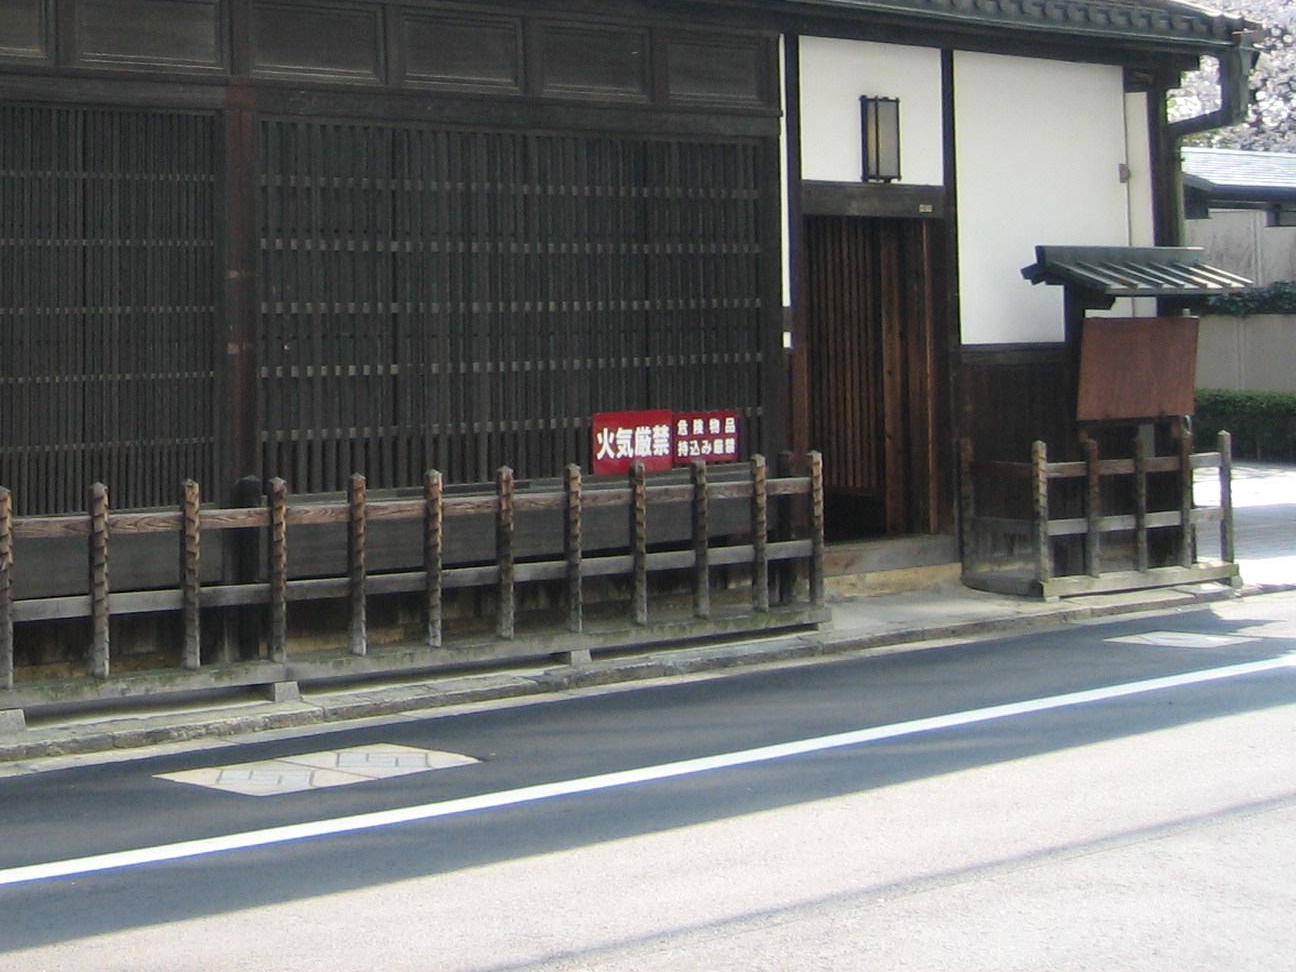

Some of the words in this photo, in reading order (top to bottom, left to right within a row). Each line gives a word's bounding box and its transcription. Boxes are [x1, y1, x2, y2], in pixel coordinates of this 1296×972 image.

[677, 417, 736, 436] 危険物品
[596, 424, 670, 460] 火気厳禁
[677, 438, 736, 457] 持込み厳禁
